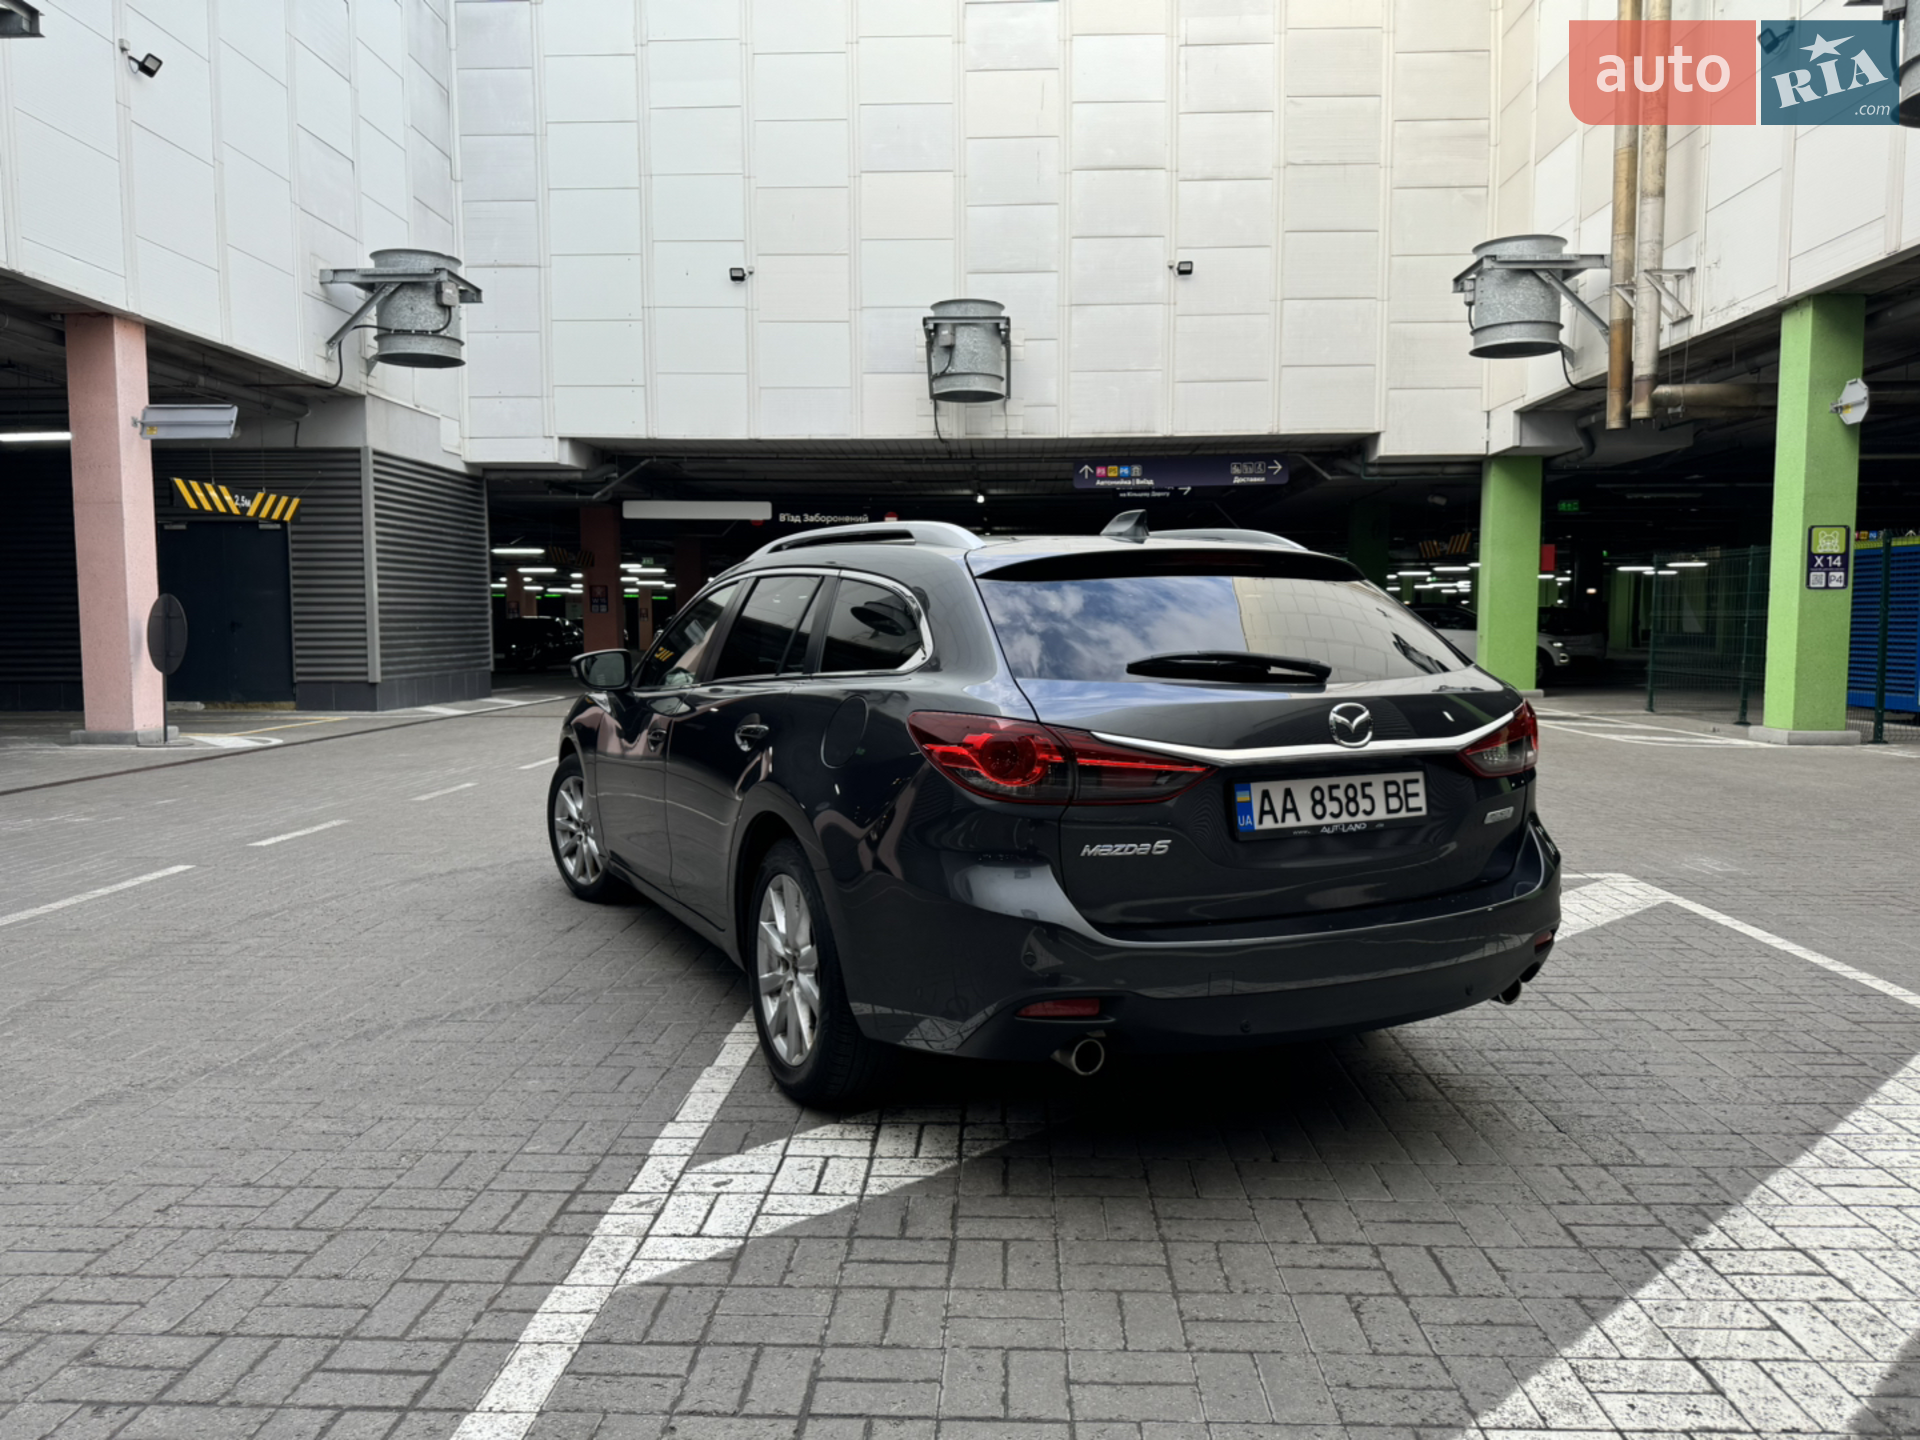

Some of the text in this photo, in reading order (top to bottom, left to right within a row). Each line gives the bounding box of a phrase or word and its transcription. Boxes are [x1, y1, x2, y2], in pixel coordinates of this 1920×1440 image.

[803, 512, 869, 524] Заборонений
[1814, 555, 1842, 567] X 14
[1829, 574, 1843, 584] P4
[1258, 778, 1423, 825] AA 8585 BE
[1237, 815, 1253, 827] UA
